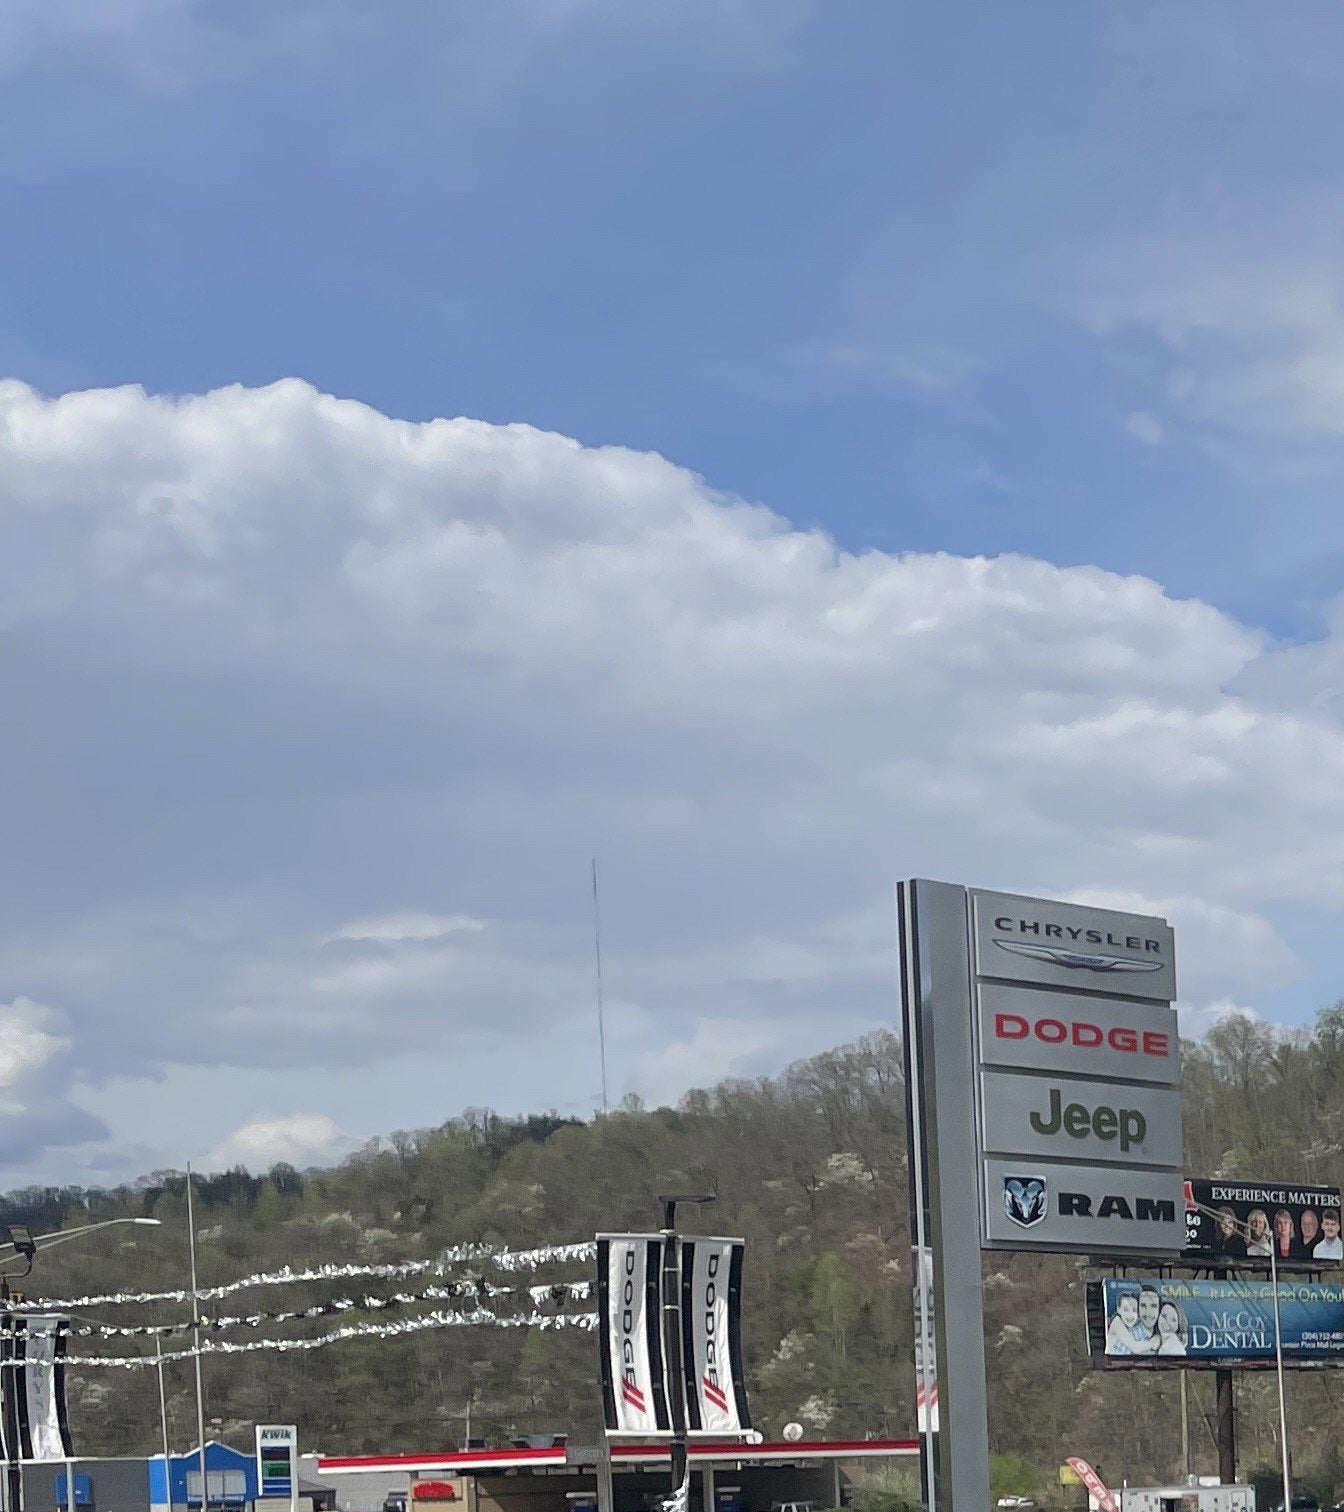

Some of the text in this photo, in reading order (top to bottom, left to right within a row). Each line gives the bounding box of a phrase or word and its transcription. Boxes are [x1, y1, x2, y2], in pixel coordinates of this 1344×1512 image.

[994, 917, 1161, 953] CHRYSLER
[995, 1013, 1169, 1056] DODGE
[1030, 1088, 1147, 1152] Jeep
[1057, 1192, 1175, 1222] RAM
[1211, 1187, 1341, 1207] EXPERIENCE MATTERS
[1298, 1287, 1318, 1302] On
[622, 1251, 638, 1389] DODGE
[705, 1254, 720, 1388] DODGE
